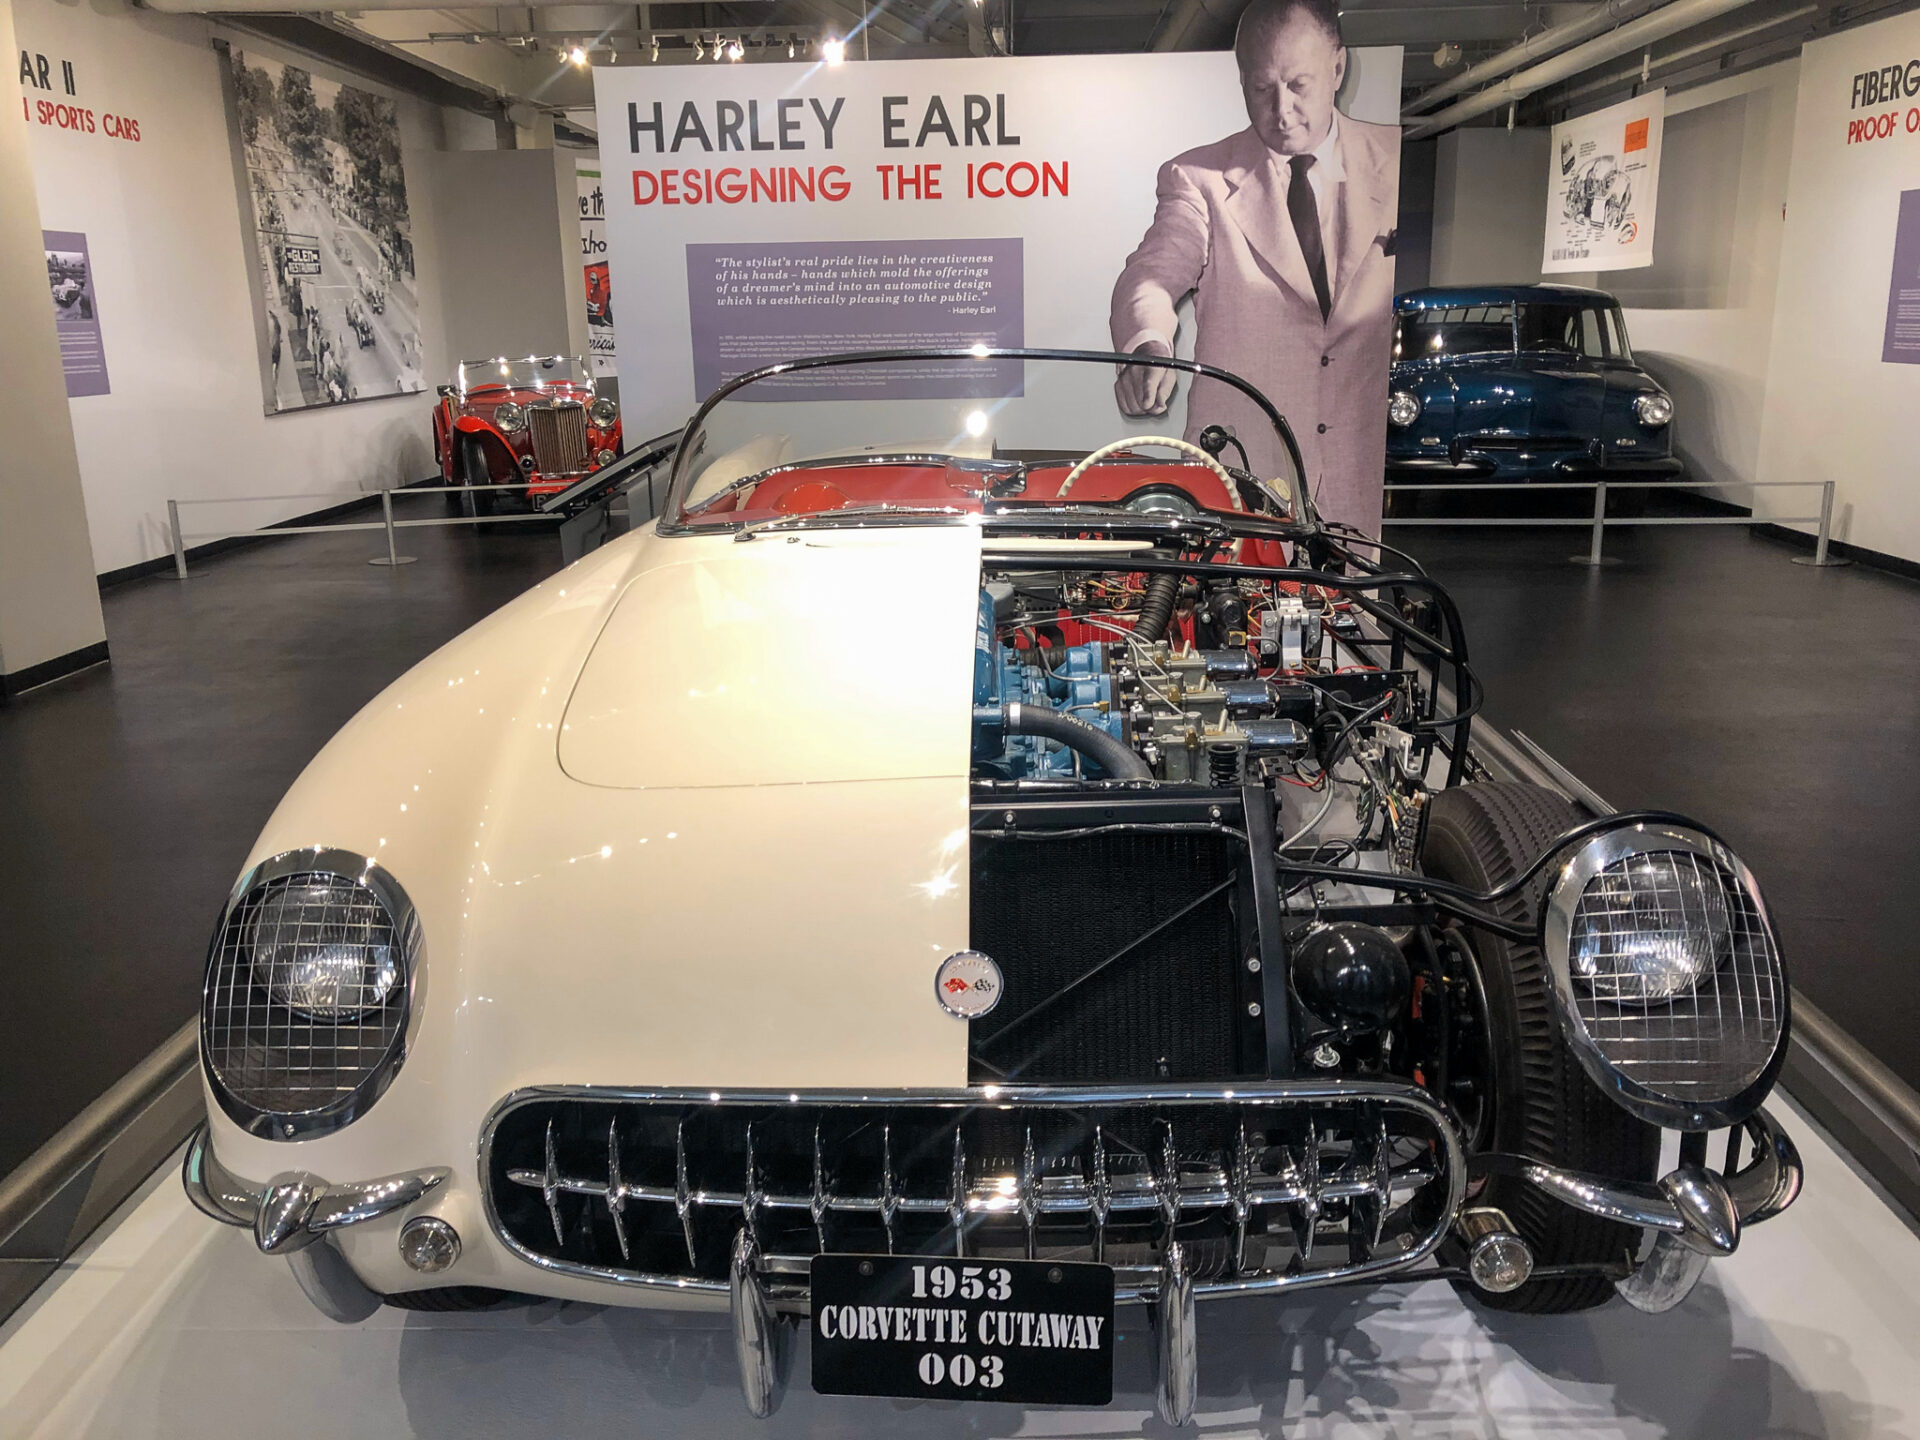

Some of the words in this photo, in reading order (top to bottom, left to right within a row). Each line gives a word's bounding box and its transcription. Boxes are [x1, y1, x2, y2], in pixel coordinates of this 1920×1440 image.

[62, 60, 76, 96] II
[1851, 59, 1920, 109] FIBERG
[37, 100, 95, 133] SPORTS
[103, 114, 140, 142] CARS
[627, 97, 846, 153] HARLEY
[882, 93, 1021, 148] EARL
[1848, 112, 1898, 144] PROOF
[632, 165, 851, 205] DESIGNING
[877, 163, 942, 200] THE
[967, 160, 1069, 199] ICON
[715, 270, 728, 281] of
[730, 270, 748, 280] his
[752, 269, 788, 280] hands
[801, 268, 837, 279] hands
[841, 268, 876, 278] which
[880, 267, 910, 278] mold
[913, 267, 932, 277] the
[935, 266, 989, 278] offerings
[794, 256, 818, 267] real
[822, 256, 854, 268] pride
[857, 255, 878, 265] lies
[882, 255, 894, 265] in
[898, 254, 917, 265] the
[920, 254, 993, 264] creativeness
[716, 283, 729, 294] of
[804, 281, 834, 292] mind
[838, 281, 862, 291] into
[865, 283, 880, 291] an
[884, 280, 950, 290] automotive
[954, 279, 992, 291] design
[717, 295, 752, 305] which
[756, 295, 767, 305] is
[770, 294, 846, 306] aesthetically
[848, 293, 900, 306] pleasing
[903, 294, 915, 303] to
[918, 292, 937, 302] the
[952, 306, 979, 315] Harley
[980, 305, 996, 314] Earl
[911, 1264, 1012, 1301] 1953
[819, 1304, 968, 1344] CORVETTE
[978, 1310, 1105, 1350] CUTAWAY
[918, 1352, 1004, 1388] 003
